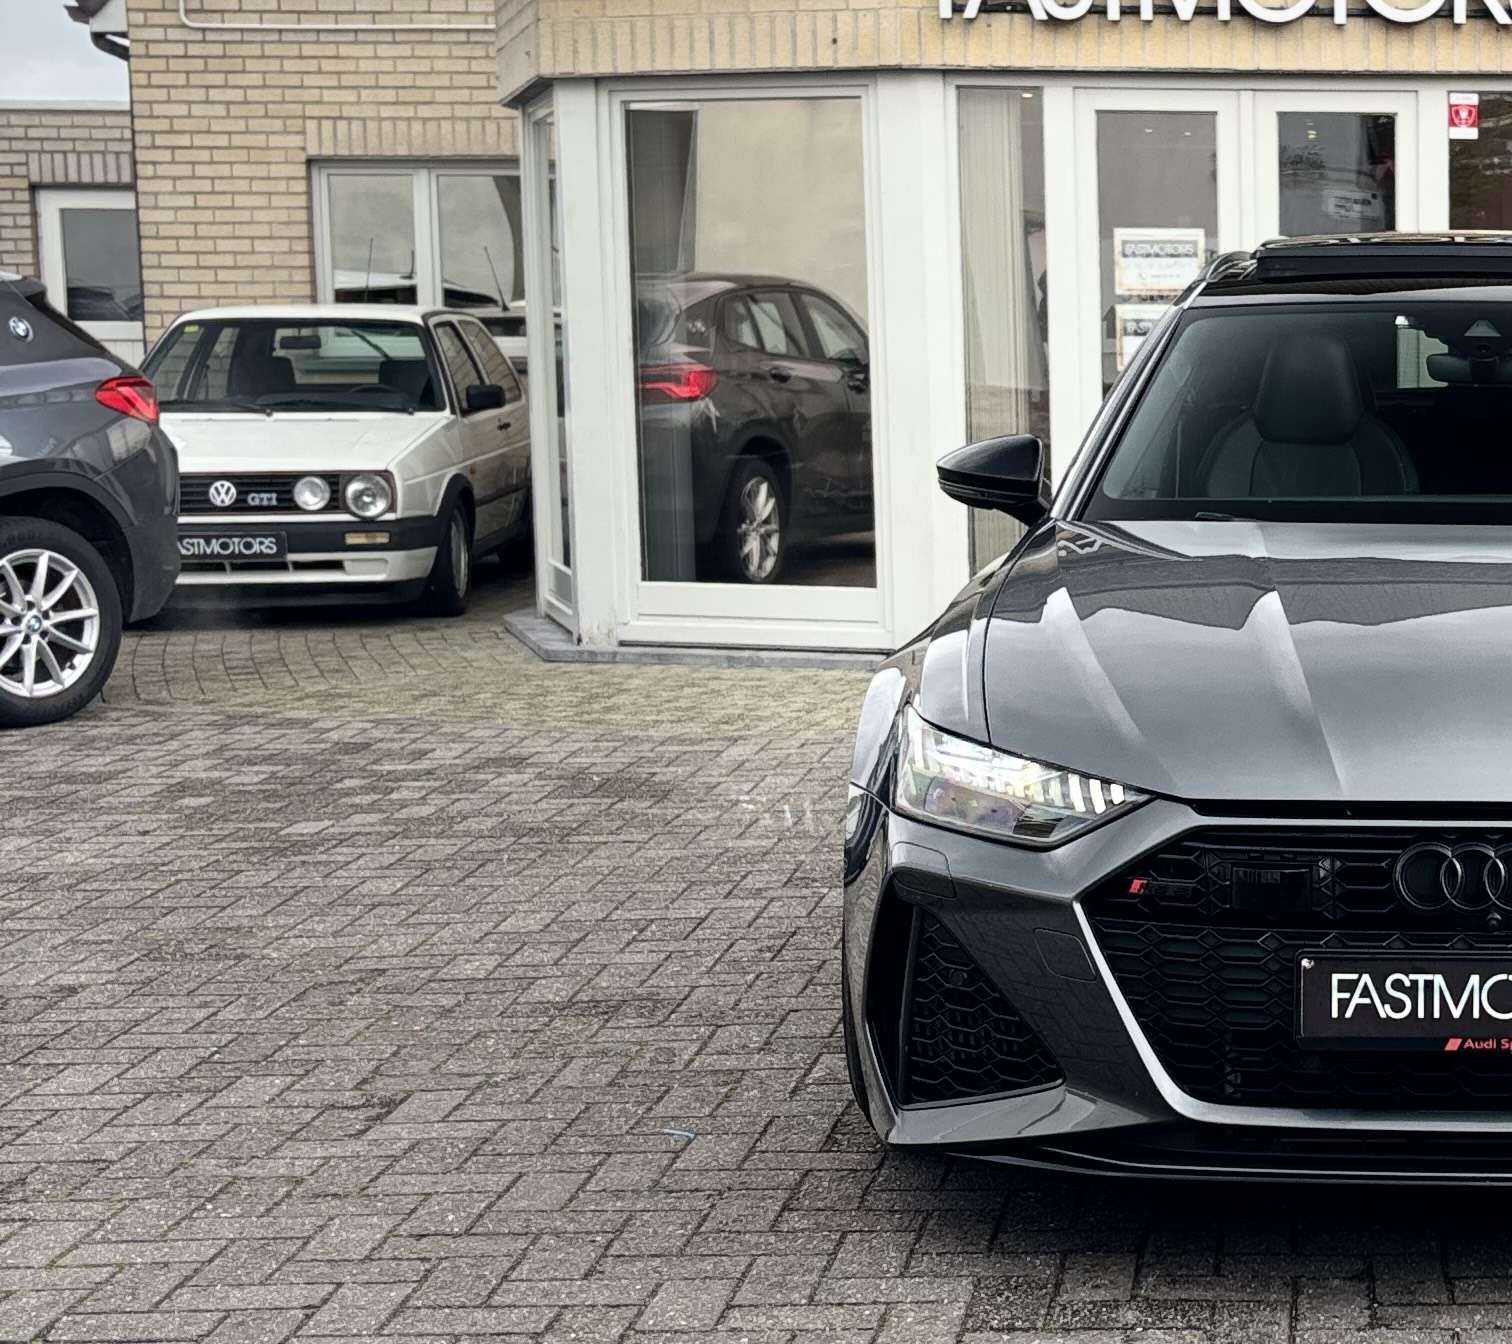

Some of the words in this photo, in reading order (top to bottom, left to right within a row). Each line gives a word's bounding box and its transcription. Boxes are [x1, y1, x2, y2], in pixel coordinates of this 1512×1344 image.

[247, 492, 278, 506] GTI
[177, 537, 278, 555] STMOTORS
[1463, 1038, 1497, 1050] Audi
